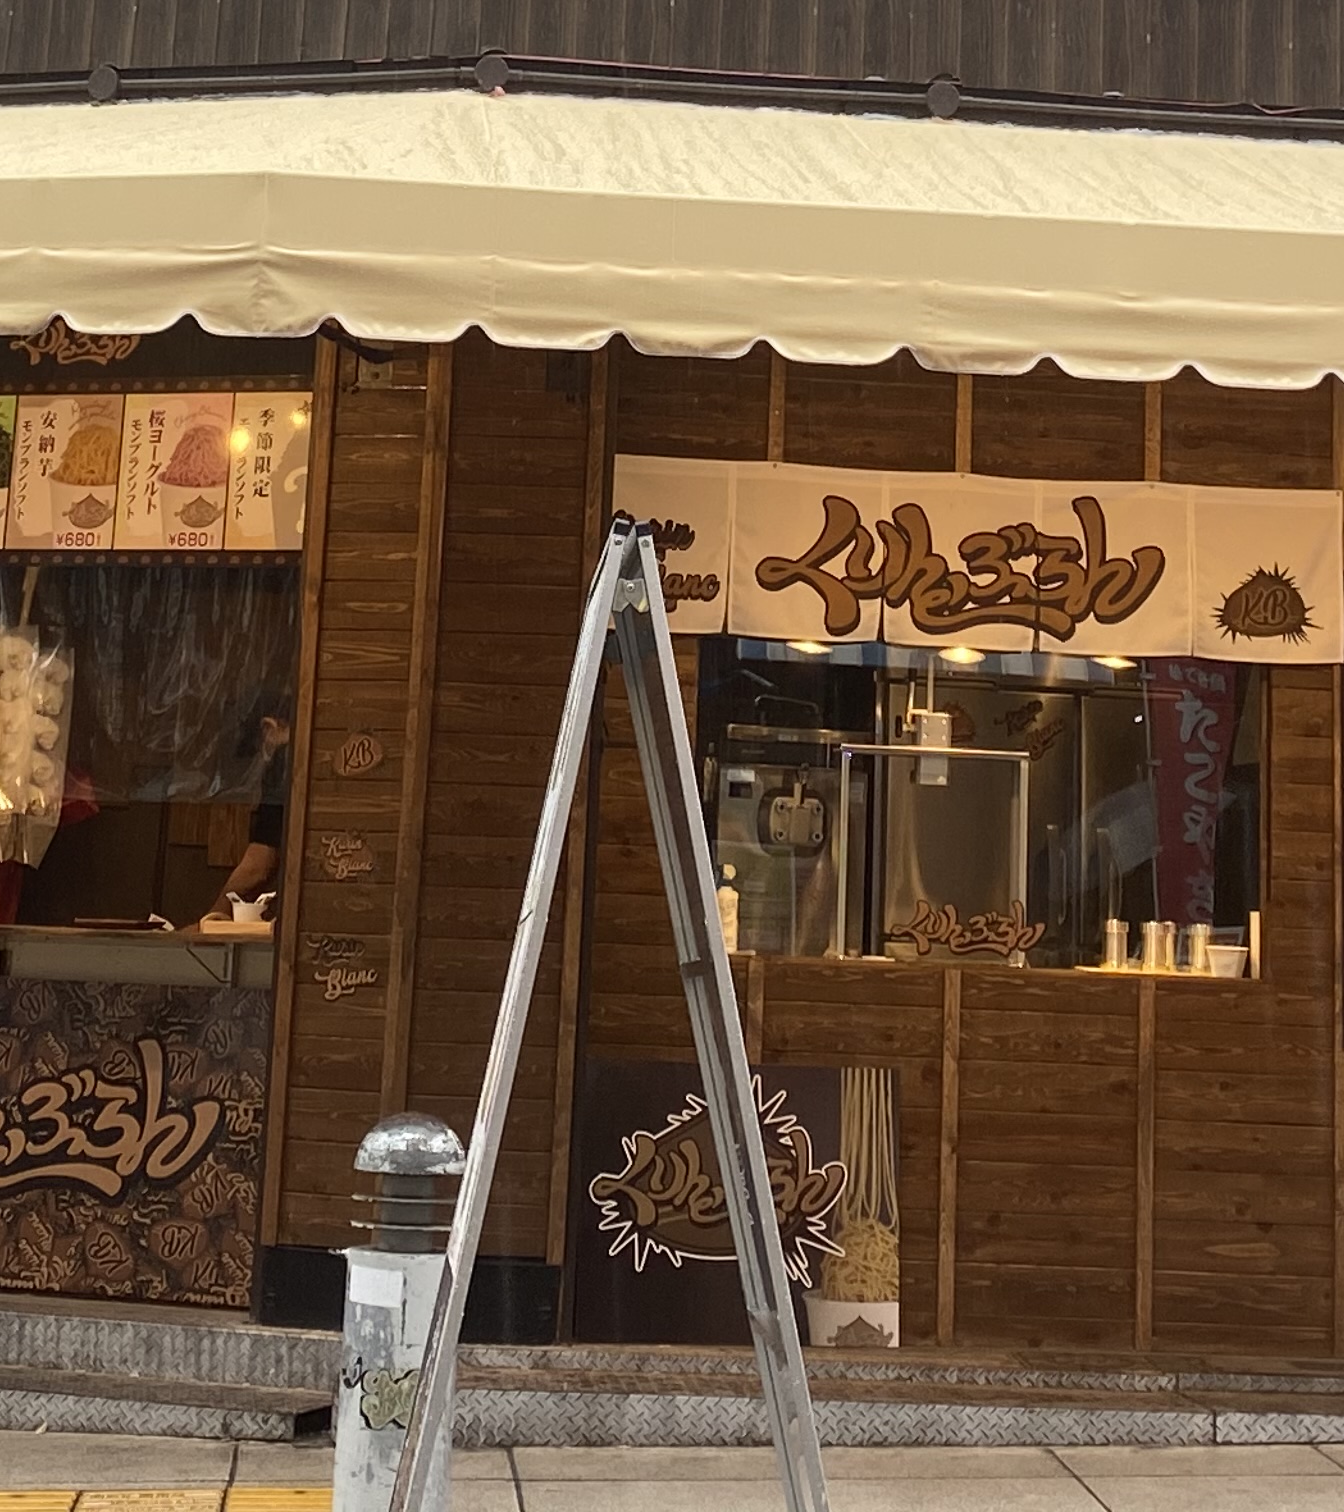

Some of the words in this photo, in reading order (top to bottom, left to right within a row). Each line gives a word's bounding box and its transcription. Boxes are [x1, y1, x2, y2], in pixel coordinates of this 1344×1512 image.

[252, 408, 276, 499] 季節限定
[56, 533, 94, 547] ¥680
[168, 533, 209, 547] ¥680
[314, 966, 378, 1001] Blanc
